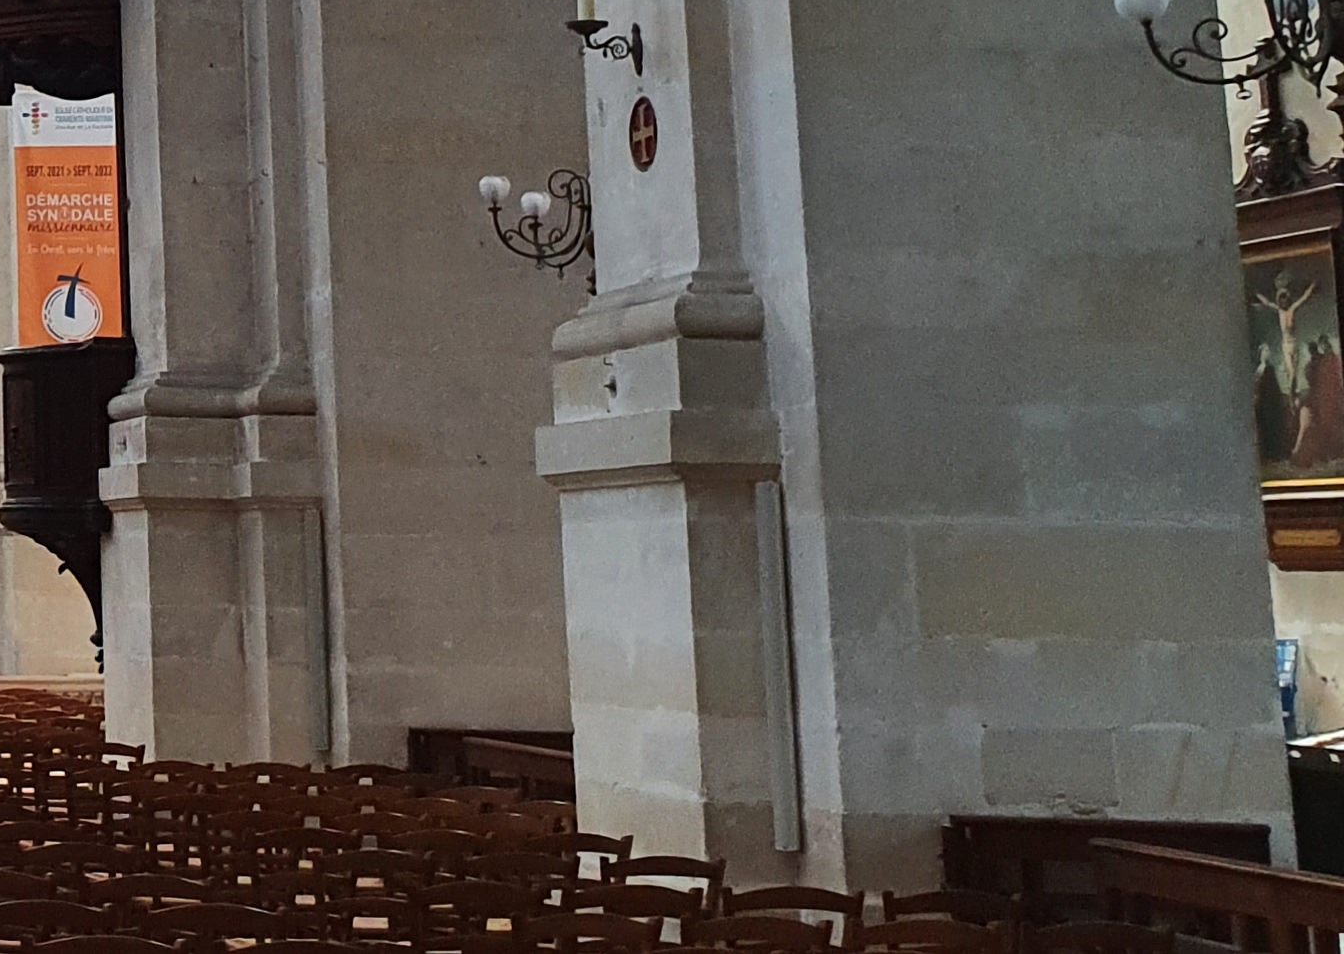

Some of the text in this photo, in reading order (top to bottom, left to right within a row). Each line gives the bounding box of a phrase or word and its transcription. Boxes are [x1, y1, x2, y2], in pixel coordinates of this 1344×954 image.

[26, 165, 45, 178] SEPT.
[47, 165, 65, 177] 2021
[26, 191, 114, 207] DÉMARCHE
[27, 222, 115, 234] missionnaire
